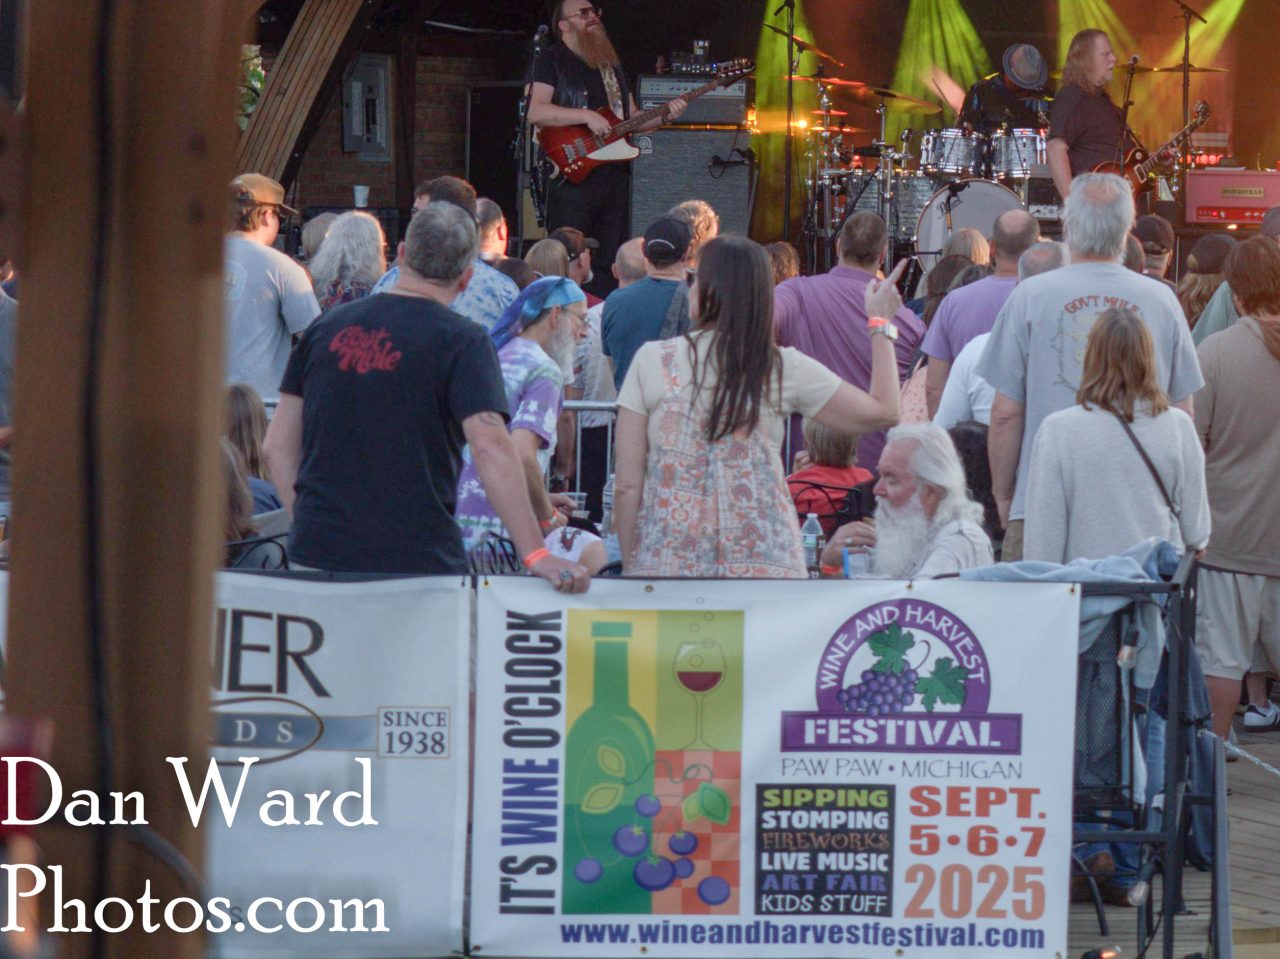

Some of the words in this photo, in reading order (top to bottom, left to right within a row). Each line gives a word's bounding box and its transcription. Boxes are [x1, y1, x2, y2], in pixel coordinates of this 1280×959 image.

[820, 633, 856, 689] WINE
[855, 606, 899, 638] AND
[905, 605, 985, 684] HARVEST
[503, 610, 562, 749] O'CLOCK
[383, 711, 448, 728] SINCE
[385, 731, 446, 755] 1938
[804, 718, 1001, 747] FESTIVAL
[781, 758, 829, 777] PAW
[835, 758, 883, 777] PAW
[902, 759, 1023, 780] MICHIGAN
[501, 758, 559, 846] WINE
[763, 789, 889, 807] SIPPING
[909, 785, 1047, 819] SEPT.
[762, 810, 889, 830] STOMPING
[762, 831, 890, 851] FIREWORKS
[761, 852, 811, 871] LIVE
[817, 852, 889, 871] MUSIC
[499, 855, 558, 915] IT'S
[762, 873, 818, 891] ART
[826, 874, 886, 892] FAIR
[903, 863, 1047, 921] 2025
[761, 894, 815, 912] KIDS
[820, 895, 888, 913] STUFF
[560, 921, 1045, 949] www.wineandharvestfestival.com
